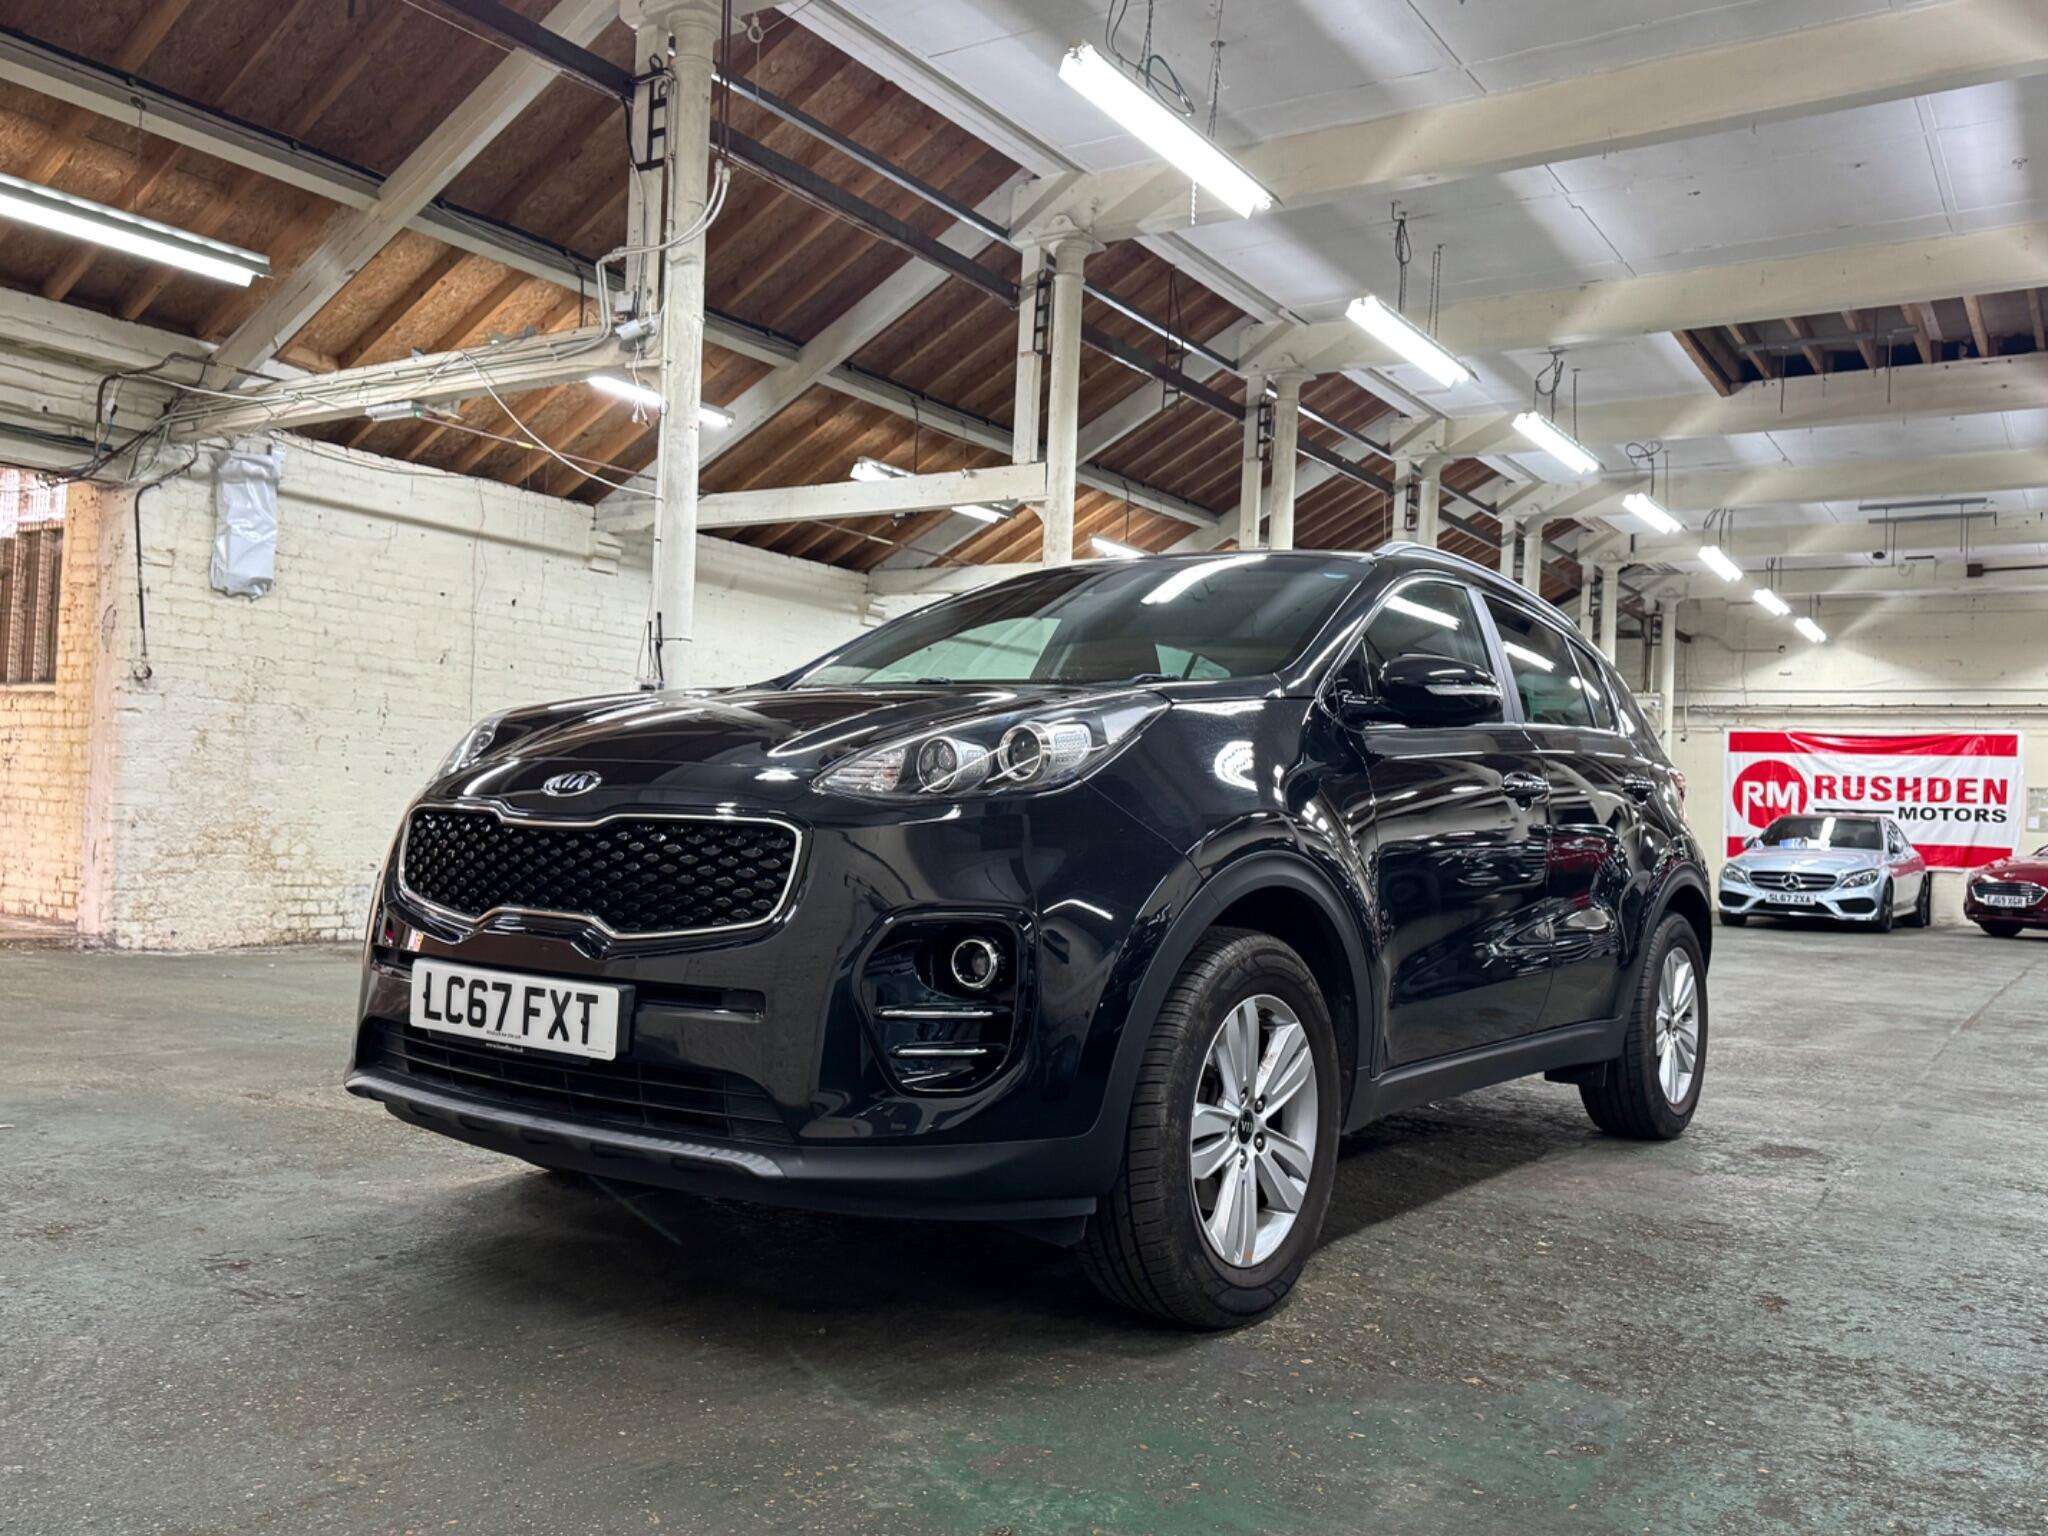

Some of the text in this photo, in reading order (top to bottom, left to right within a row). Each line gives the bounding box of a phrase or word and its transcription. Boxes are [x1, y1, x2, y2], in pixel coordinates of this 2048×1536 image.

[549, 774, 589, 790] KIA
[1814, 774, 2009, 806] RUSHDEN
[1742, 780, 1800, 822] RM
[1898, 806, 2008, 824] MOTORS
[423, 971, 599, 1045] LC67 FXT
